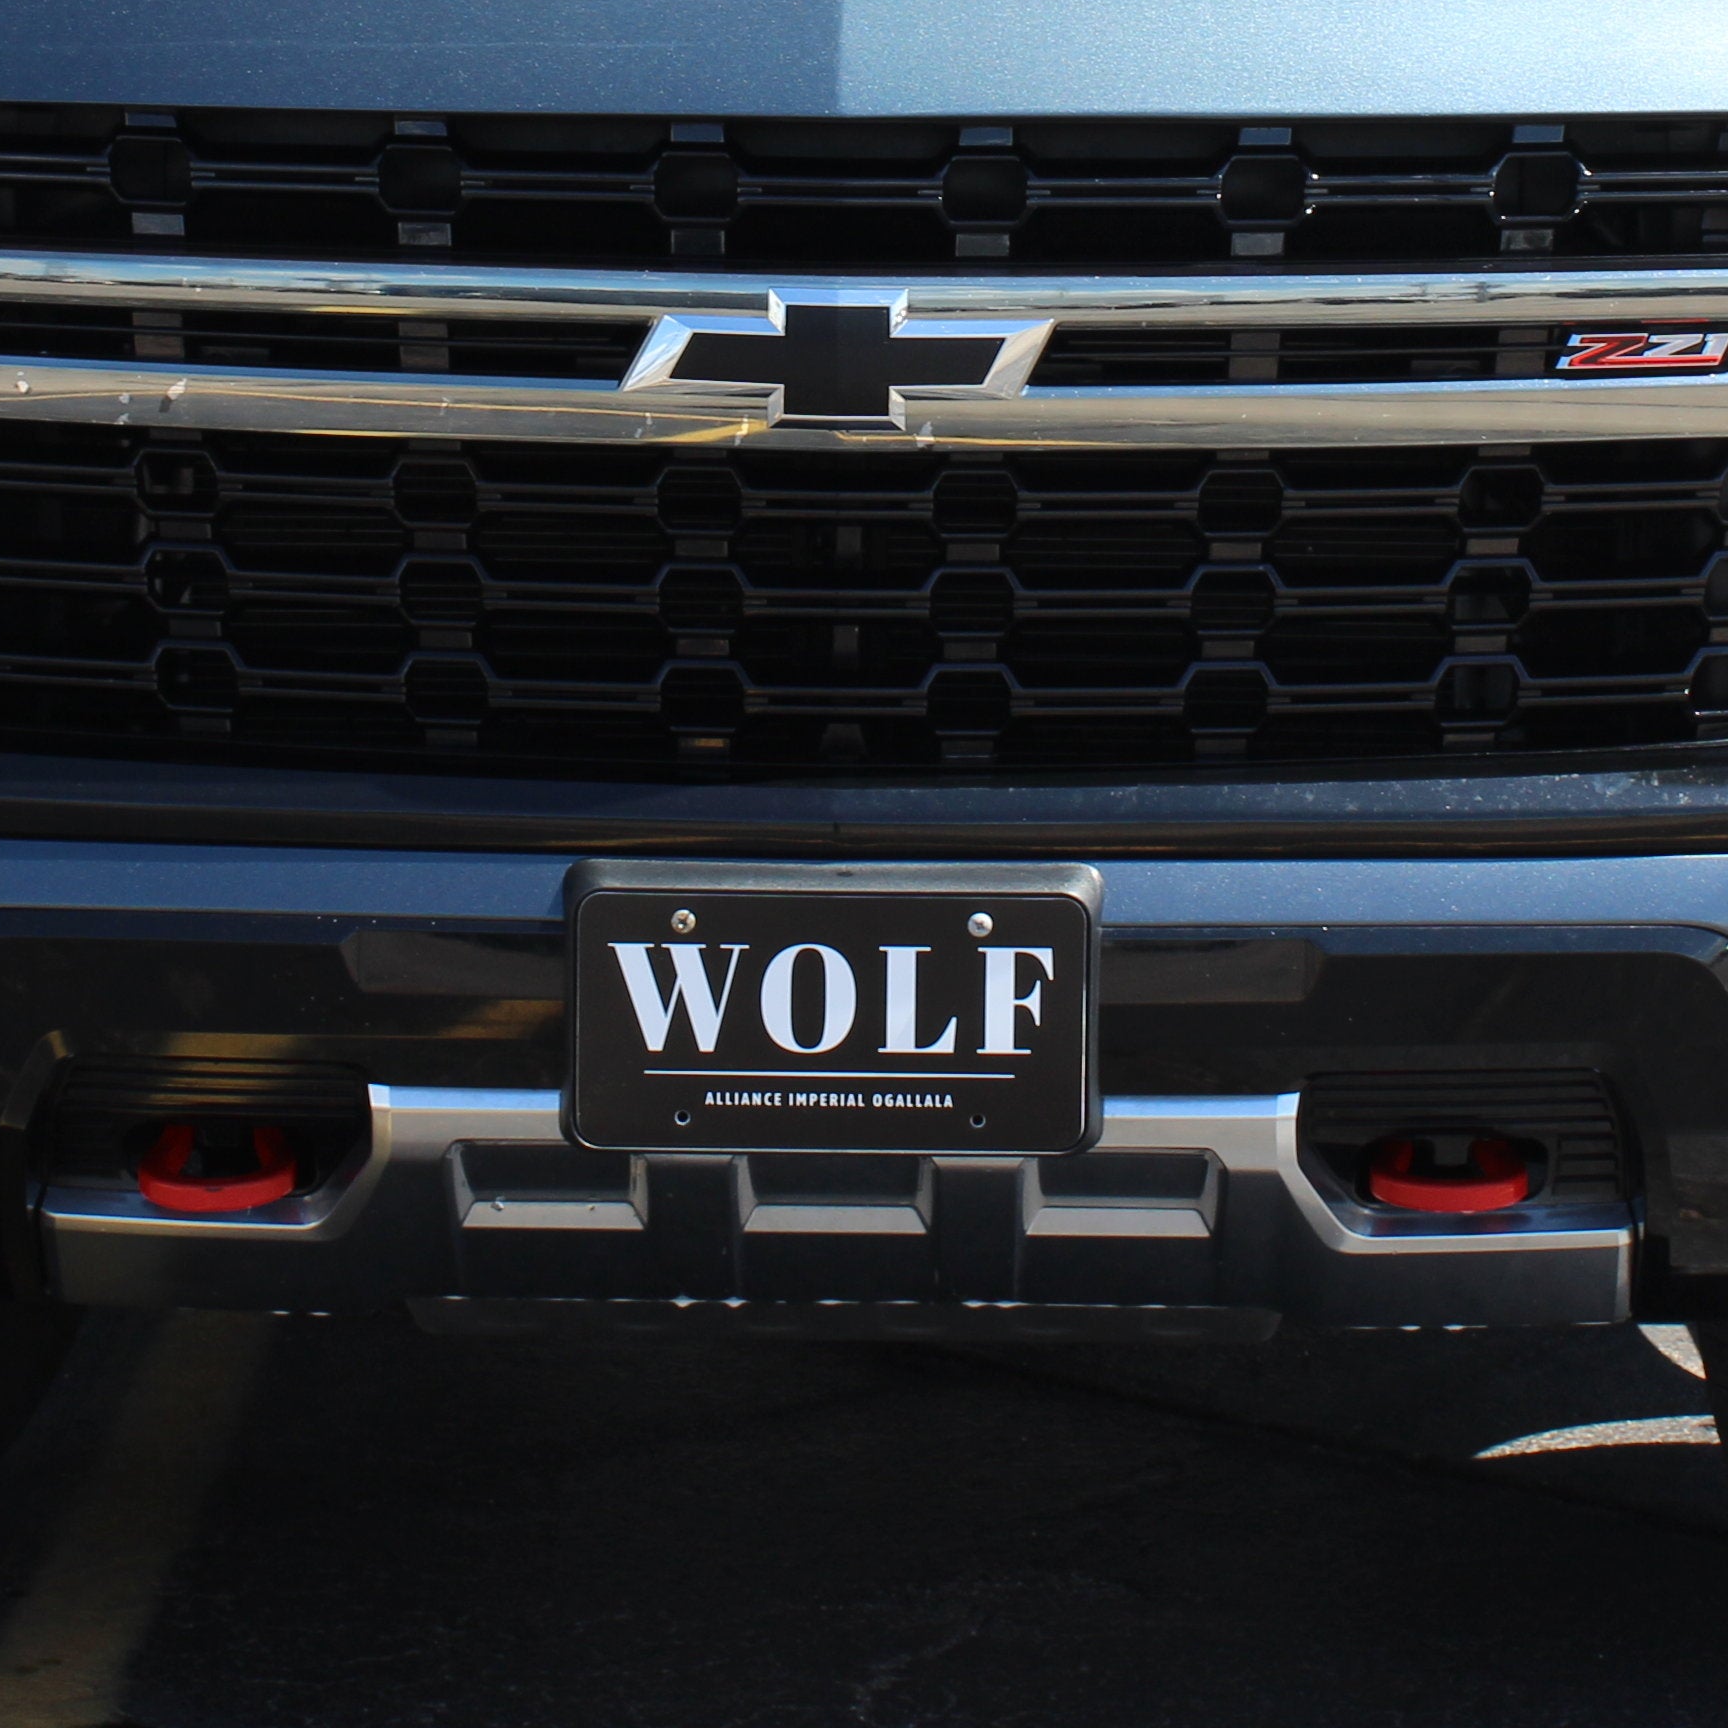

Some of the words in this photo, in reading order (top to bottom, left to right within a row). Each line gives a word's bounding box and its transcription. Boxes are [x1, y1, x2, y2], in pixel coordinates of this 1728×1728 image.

[607, 942, 1055, 1055] WOLF
[704, 1091, 783, 1107] ALLIANCE
[788, 1092, 866, 1108] IMPERIAL
[872, 1093, 954, 1109] OGALLALA
